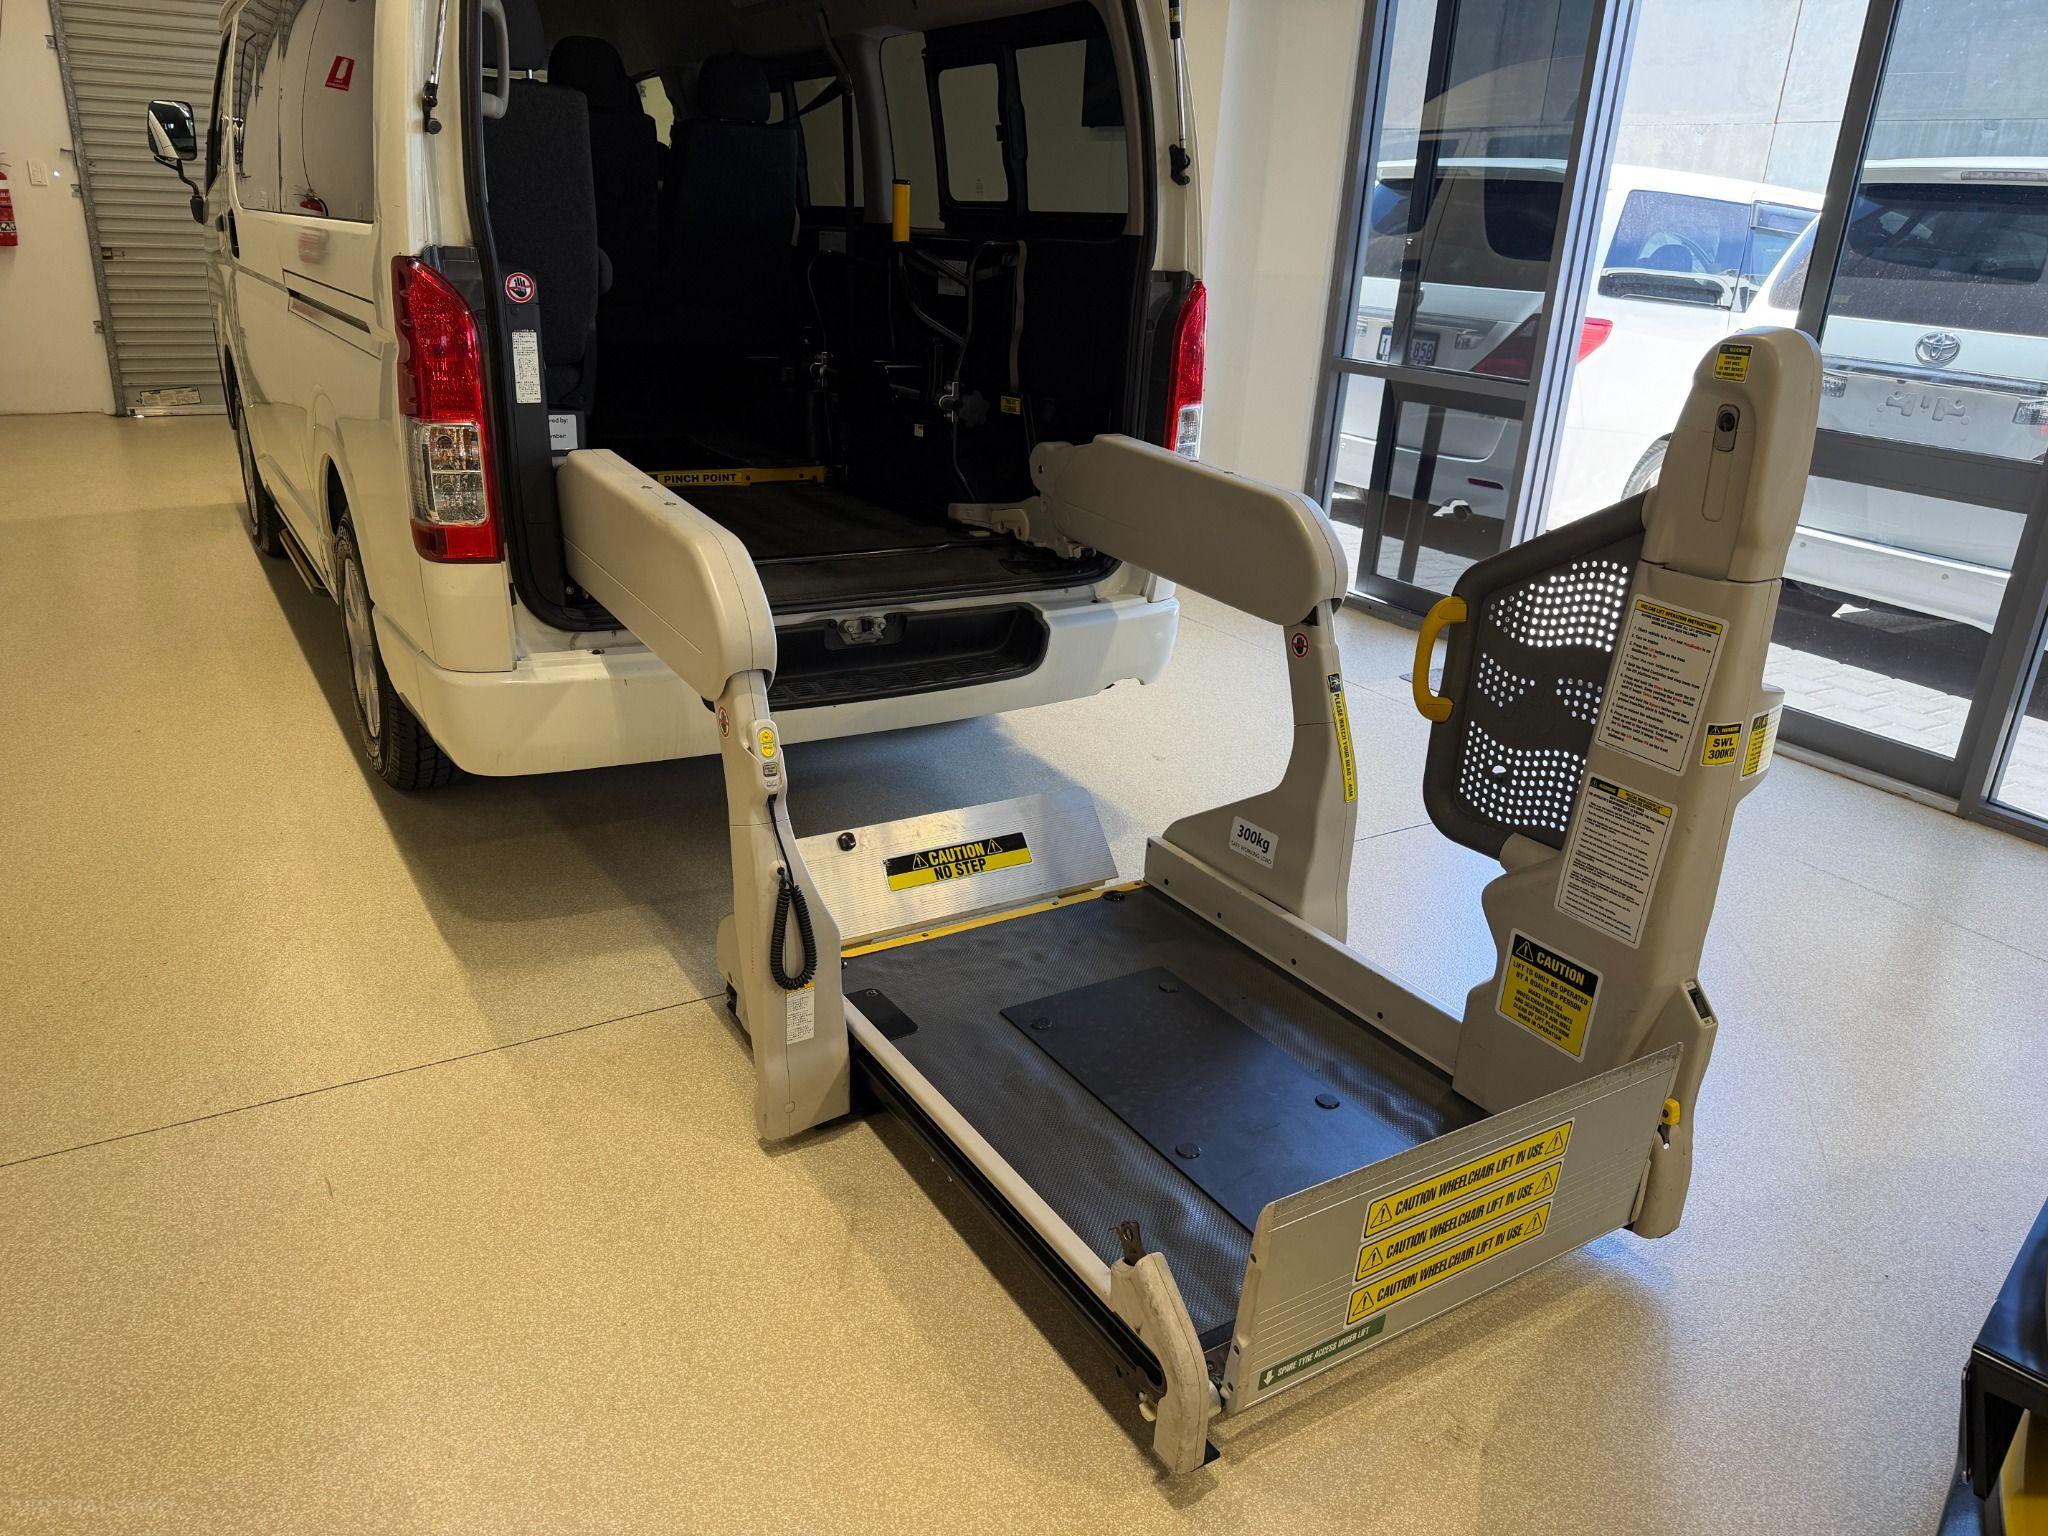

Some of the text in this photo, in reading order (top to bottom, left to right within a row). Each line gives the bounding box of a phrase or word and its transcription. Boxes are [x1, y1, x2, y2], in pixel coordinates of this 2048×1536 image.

[1413, 341, 1434, 360] 858
[664, 472, 737, 484] PINCH POINT
[1687, 617, 1717, 630] INSTRUCTIONS
[1334, 693, 1343, 716] PLEASE
[1338, 718, 1346, 739] WATCH
[1341, 742, 1349, 758] YOUR
[1708, 747, 1735, 760] 300KG
[1713, 737, 1734, 748] SWL
[1237, 824, 1270, 853] 300kg
[928, 842, 986, 866] CAUTION
[934, 858, 987, 881] NO STEP
[1536, 950, 1585, 986] CAUTION
[1512, 960, 1588, 1005] LIFT TO ONLY BE OPERATED
[1516, 971, 1523, 980] BY
[1529, 978, 1557, 999] QUALIFIED
[1559, 994, 1581, 1012] PERSON
[1394, 1141, 1544, 1217] CAUTION WHEELCHAIR LIFT IN USE
[1385, 1181, 1533, 1260] CAUTION WHEELCHAIR LIFT IN USE
[1376, 1222, 1523, 1303] CAUTION WHEELCHAIR LIFT IN USE
[1278, 1326, 1369, 1376] SPARE TYRE ACCESS UNDER LIFT
